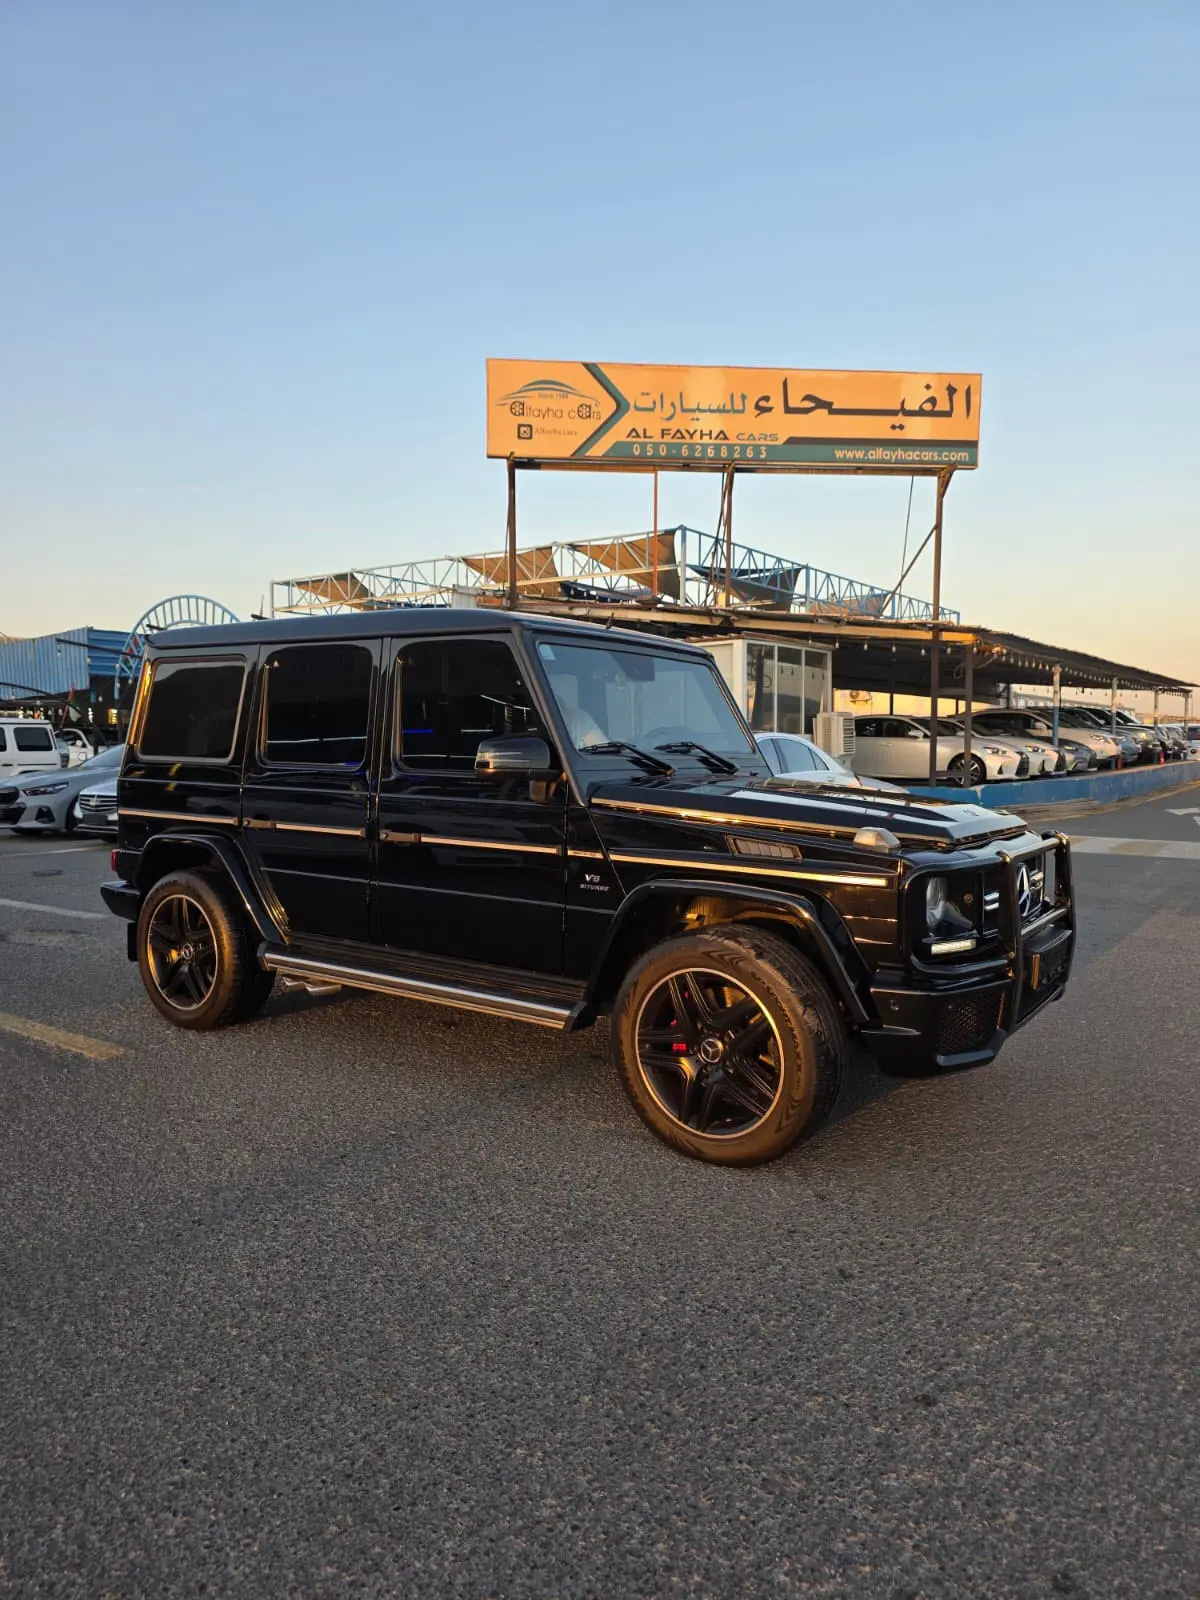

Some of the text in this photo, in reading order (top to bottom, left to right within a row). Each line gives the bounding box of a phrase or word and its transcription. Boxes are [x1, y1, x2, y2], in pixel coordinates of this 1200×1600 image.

[633, 377, 971, 431] الفيحاء للسيارات
[626, 427, 778, 442] AL FAYHA CARS
[835, 448, 969, 462] www.alfayhacars.com
